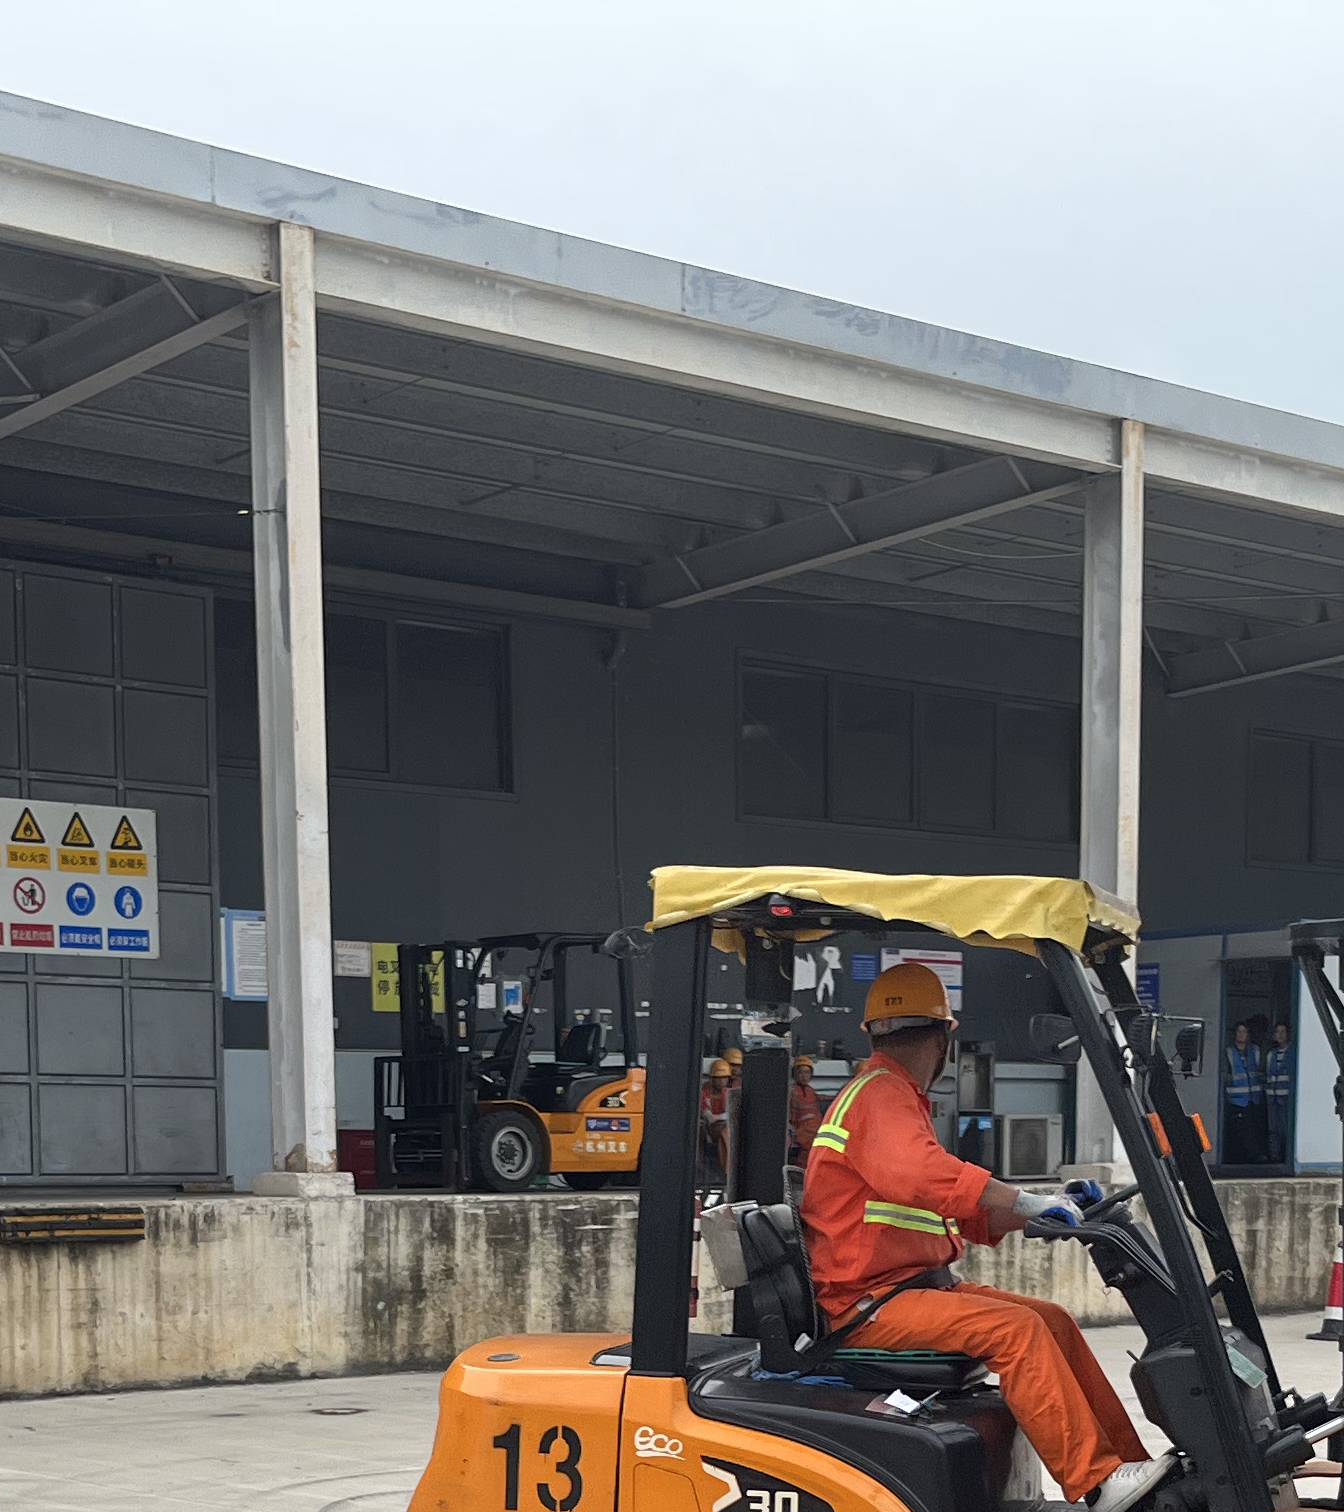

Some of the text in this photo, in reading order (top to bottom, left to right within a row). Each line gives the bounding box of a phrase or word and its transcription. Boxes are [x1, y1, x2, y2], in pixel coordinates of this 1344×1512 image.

[9, 850, 49, 864] 当心火灾
[493, 1423, 583, 1512] 13
